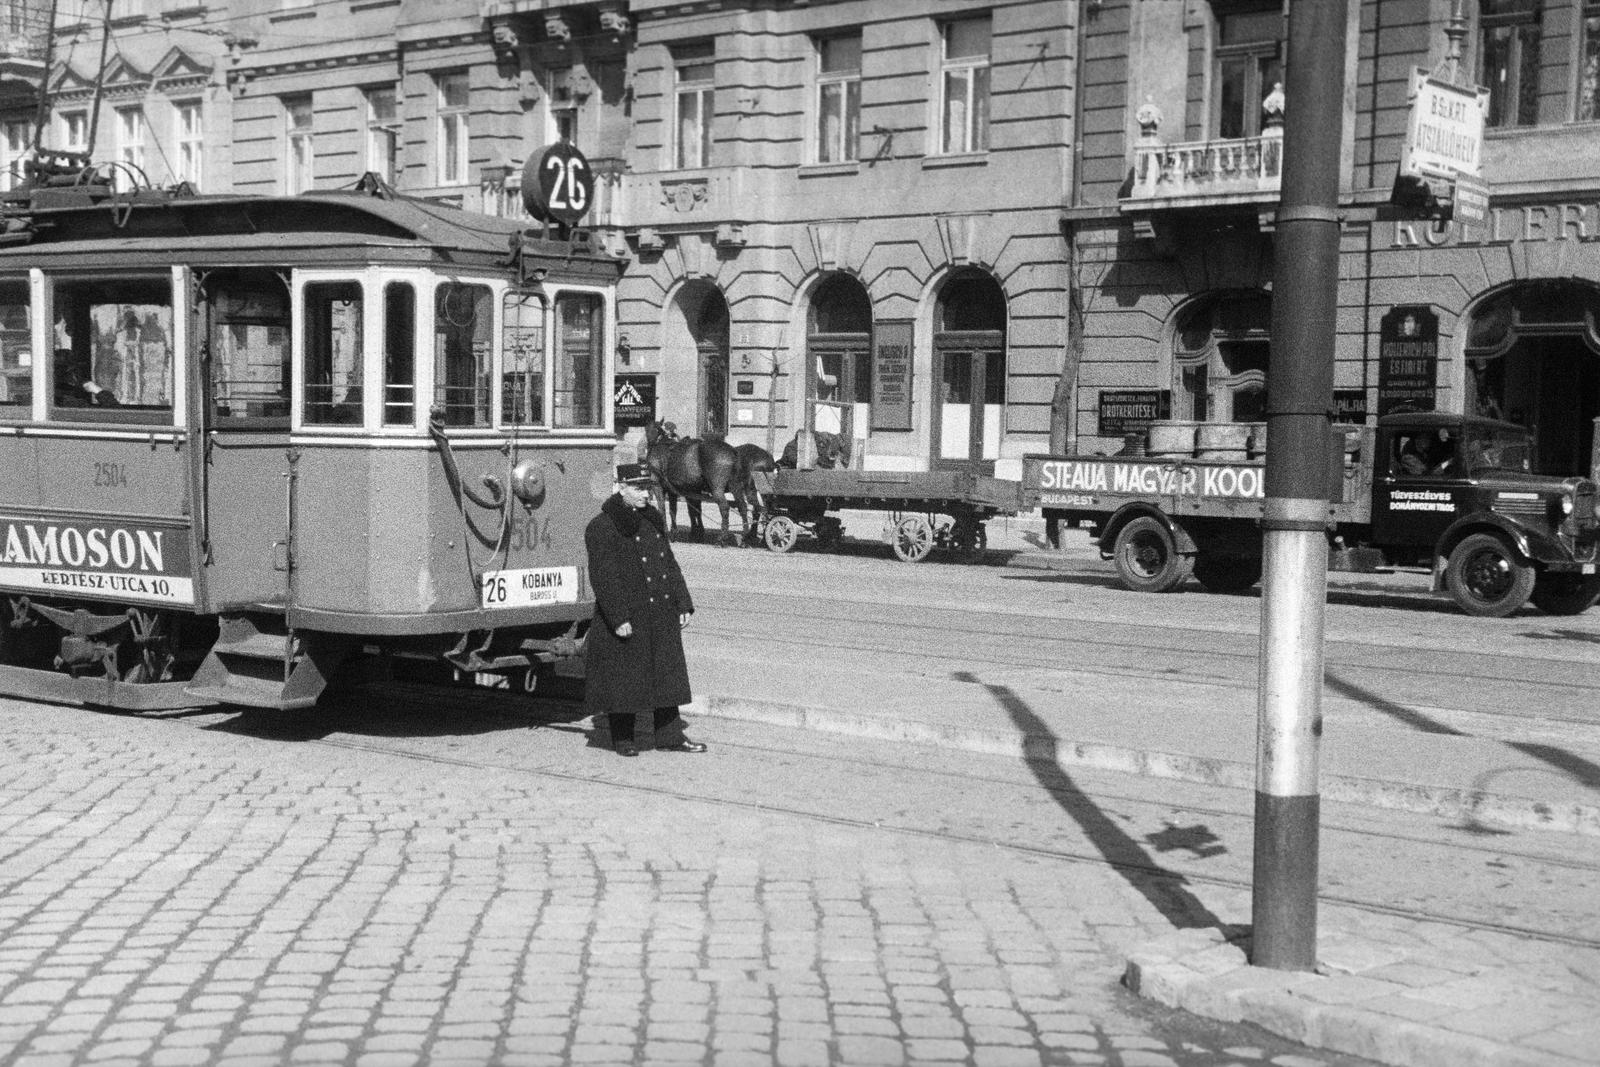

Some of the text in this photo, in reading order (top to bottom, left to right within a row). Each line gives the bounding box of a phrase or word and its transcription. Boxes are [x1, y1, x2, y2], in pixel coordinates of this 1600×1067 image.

[546, 155, 586, 211] 26
[94, 461, 128, 489] 2504
[1041, 461, 1108, 491] STEAUA
[1113, 463, 1197, 495] MAGYAR
[1041, 494, 1095, 505] BUDAPEST
[0, 524, 164, 573] AMOSON
[497, 517, 552, 552] 504
[486, 577, 507, 603] 26
